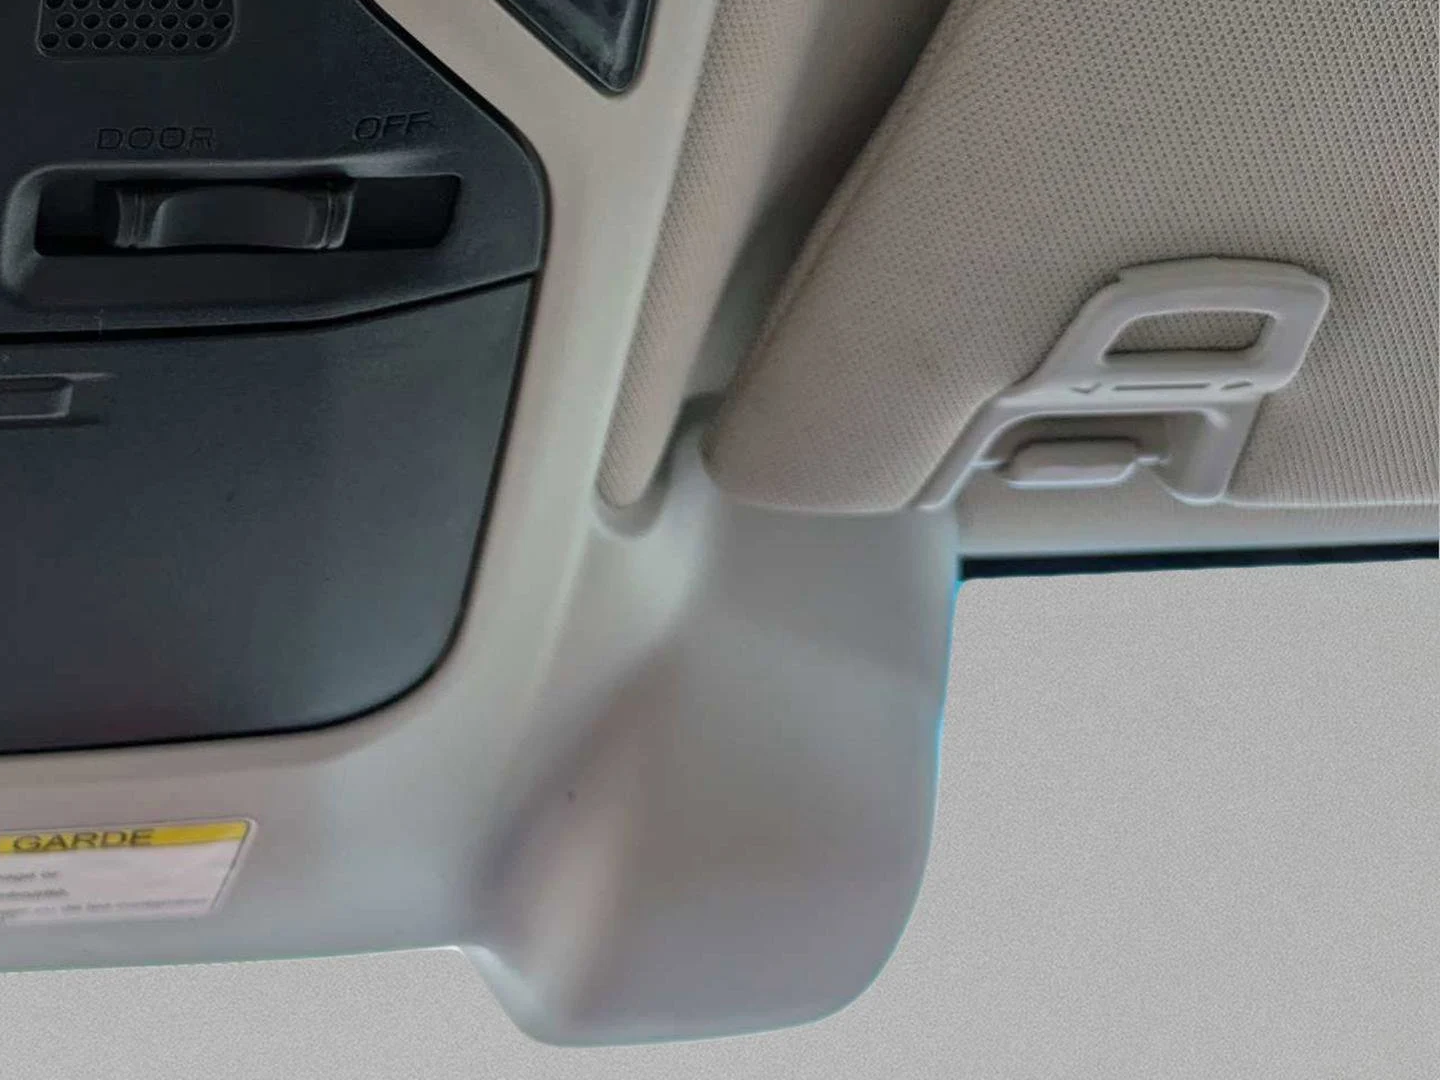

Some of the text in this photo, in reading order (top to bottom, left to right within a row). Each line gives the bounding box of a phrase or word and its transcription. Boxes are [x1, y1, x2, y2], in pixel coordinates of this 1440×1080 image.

[96, 126, 216, 152] DOOR
[351, 111, 432, 142] OFF
[12, 829, 153, 853] GARDE
